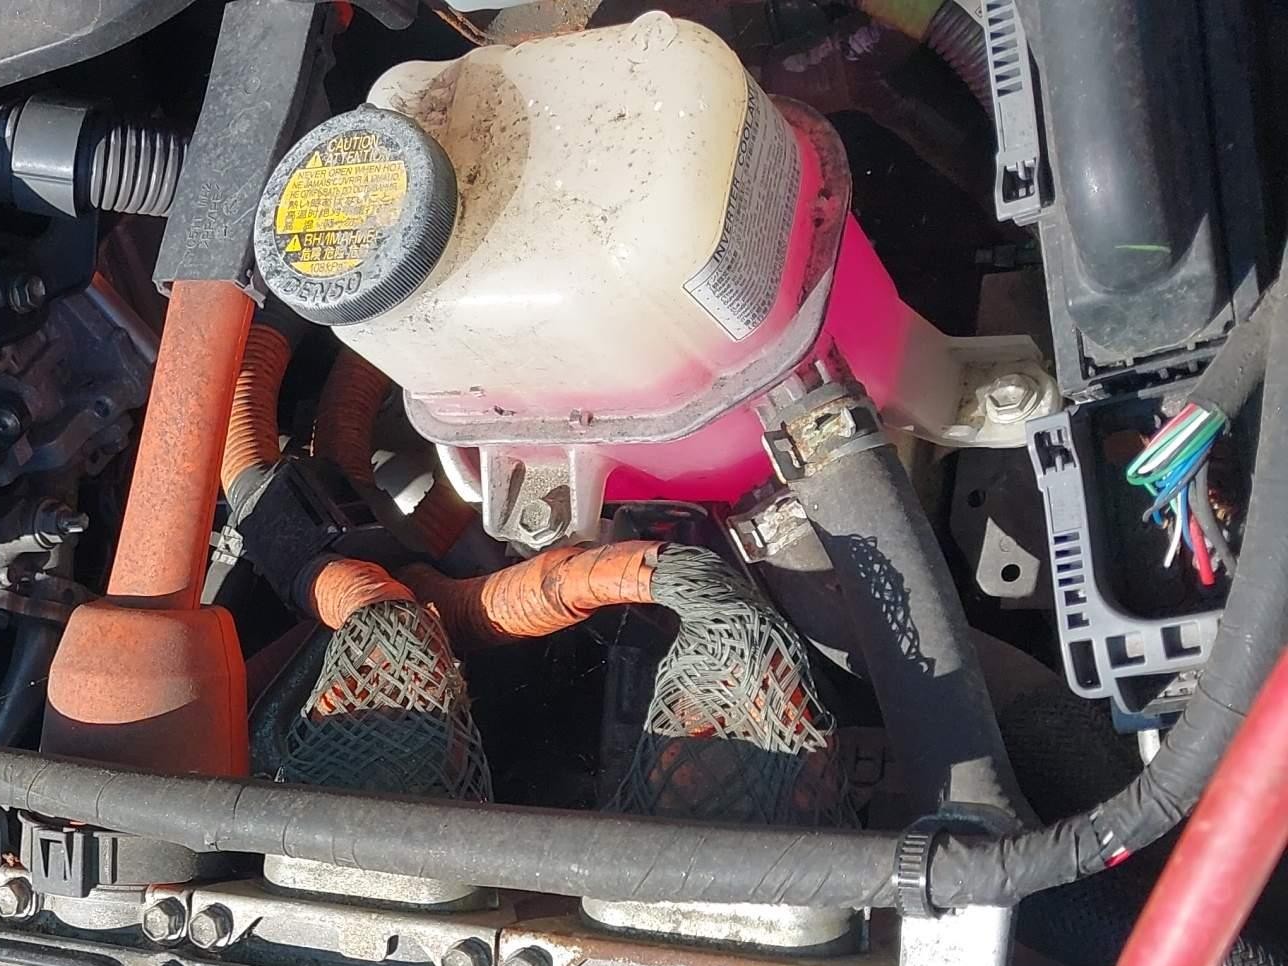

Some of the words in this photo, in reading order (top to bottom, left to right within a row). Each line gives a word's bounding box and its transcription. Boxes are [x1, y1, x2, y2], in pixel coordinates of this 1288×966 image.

[328, 135, 379, 152] CAUTION
[325, 149, 390, 166] ATTENTION
[299, 169, 327, 179] NEVER
[329, 167, 352, 178] OPEN
[383, 163, 401, 173] HOT
[713, 178, 740, 263] INVERTER
